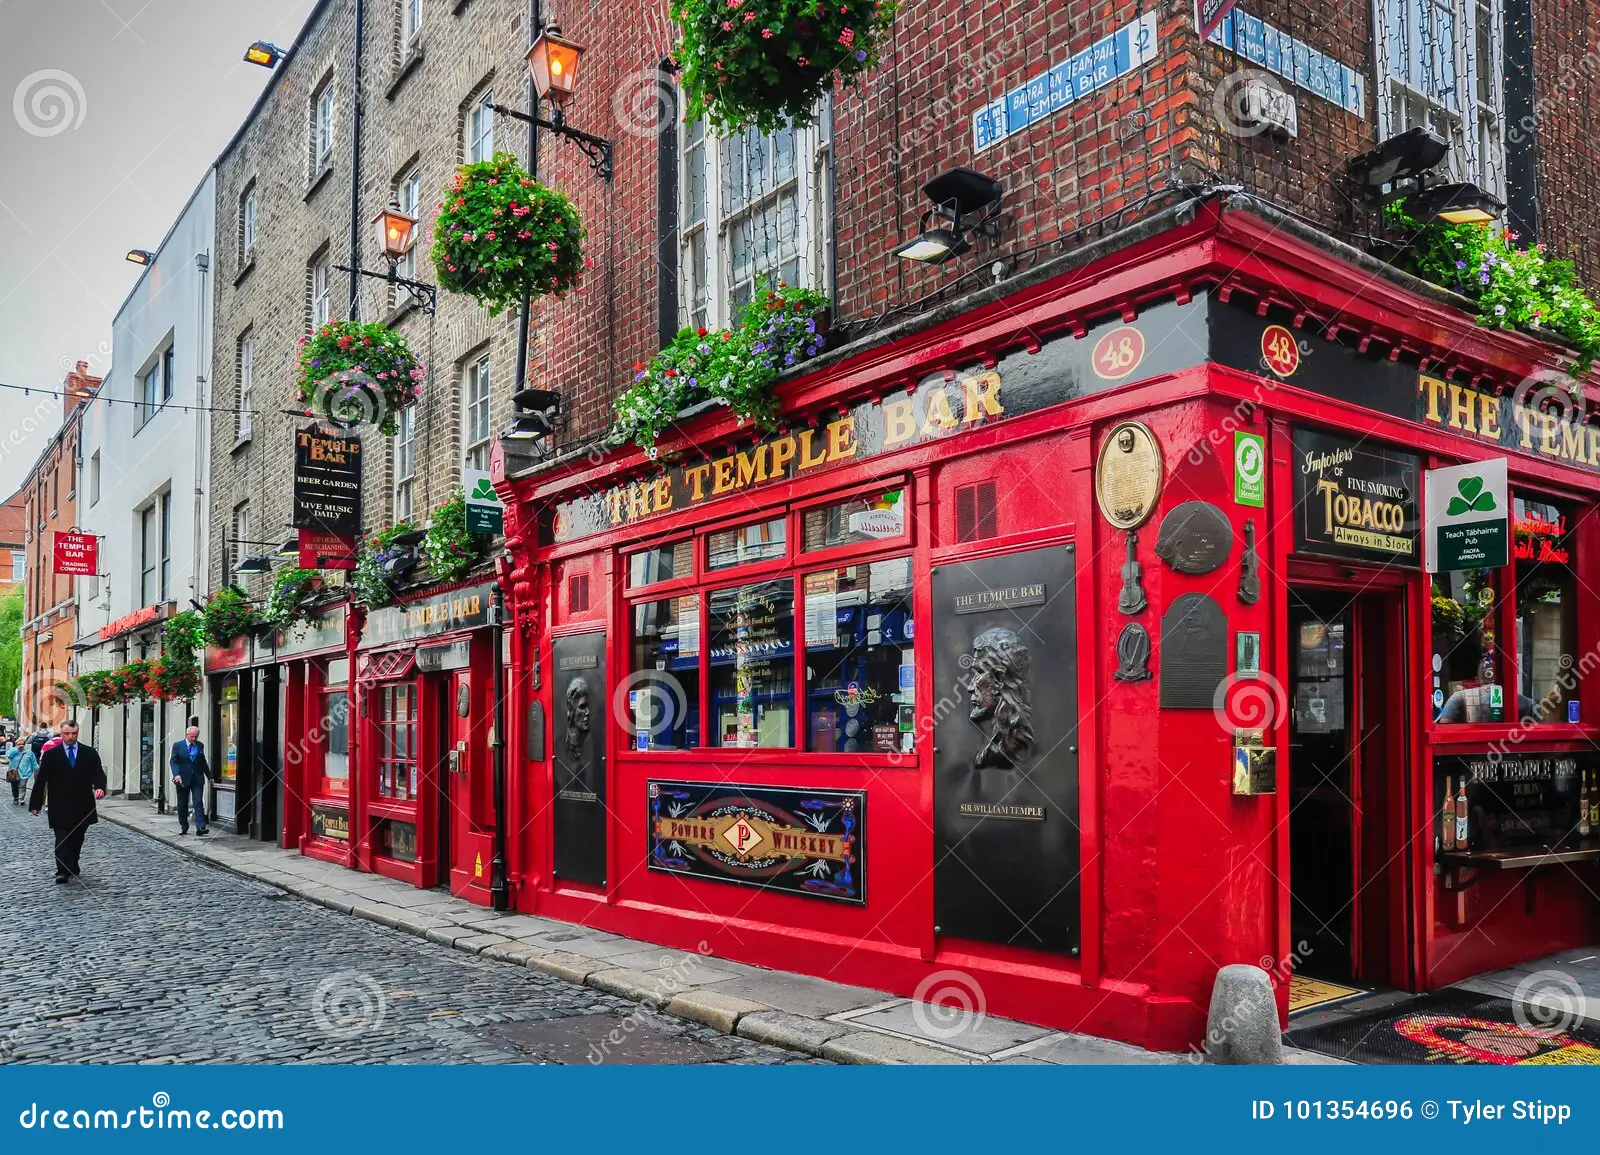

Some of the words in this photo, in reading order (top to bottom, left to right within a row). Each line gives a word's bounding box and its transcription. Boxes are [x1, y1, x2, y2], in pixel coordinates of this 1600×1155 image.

[1137, 27, 1150, 54] 2
[1023, 83, 1073, 121] TEMPLE
[1079, 66, 1108, 91] BAR
[1100, 334, 1134, 371] 48
[1267, 332, 1291, 366] 48
[1418, 374, 1501, 440] THE
[310, 446, 346, 464] BAR
[606, 476, 673, 523] THE
[685, 416, 857, 502] TEMPLE
[882, 371, 1004, 447] BAR
[1302, 447, 1353, 478] Importers
[1334, 467, 1344, 477] OF
[297, 476, 321, 486] BEER
[322, 479, 358, 490] GARDEN
[1348, 477, 1367, 492] FINE
[1367, 481, 1404, 500] SMOKING
[301, 501, 322, 511] LIVE
[324, 504, 353, 514] MUSIC
[314, 509, 342, 519] DAILY
[58, 542, 93, 551] TEMPLE
[67, 535, 84, 543] THE
[1336, 528, 1370, 545] Always
[1374, 535, 1383, 546] in
[1385, 536, 1411, 552] Stock
[1445, 531, 1465, 539] Teach
[1458, 553, 1486, 561] APPROVED
[955, 595, 974, 606] THE
[977, 588, 1018, 604] TEMPLE
[1021, 585, 1043, 597] BAR
[402, 604, 448, 632] TEMPLE
[452, 595, 481, 618] BAR
[1470, 761, 1499, 782] THE
[1502, 759, 1551, 780] TEMPLE
[960, 804, 972, 812] SIR
[973, 805, 1008, 814] WILLIAM
[1010, 806, 1043, 816] TEMPLE
[671, 821, 715, 841] POWERS
[738, 823, 751, 851] P
[772, 832, 836, 855] WHISKEY
